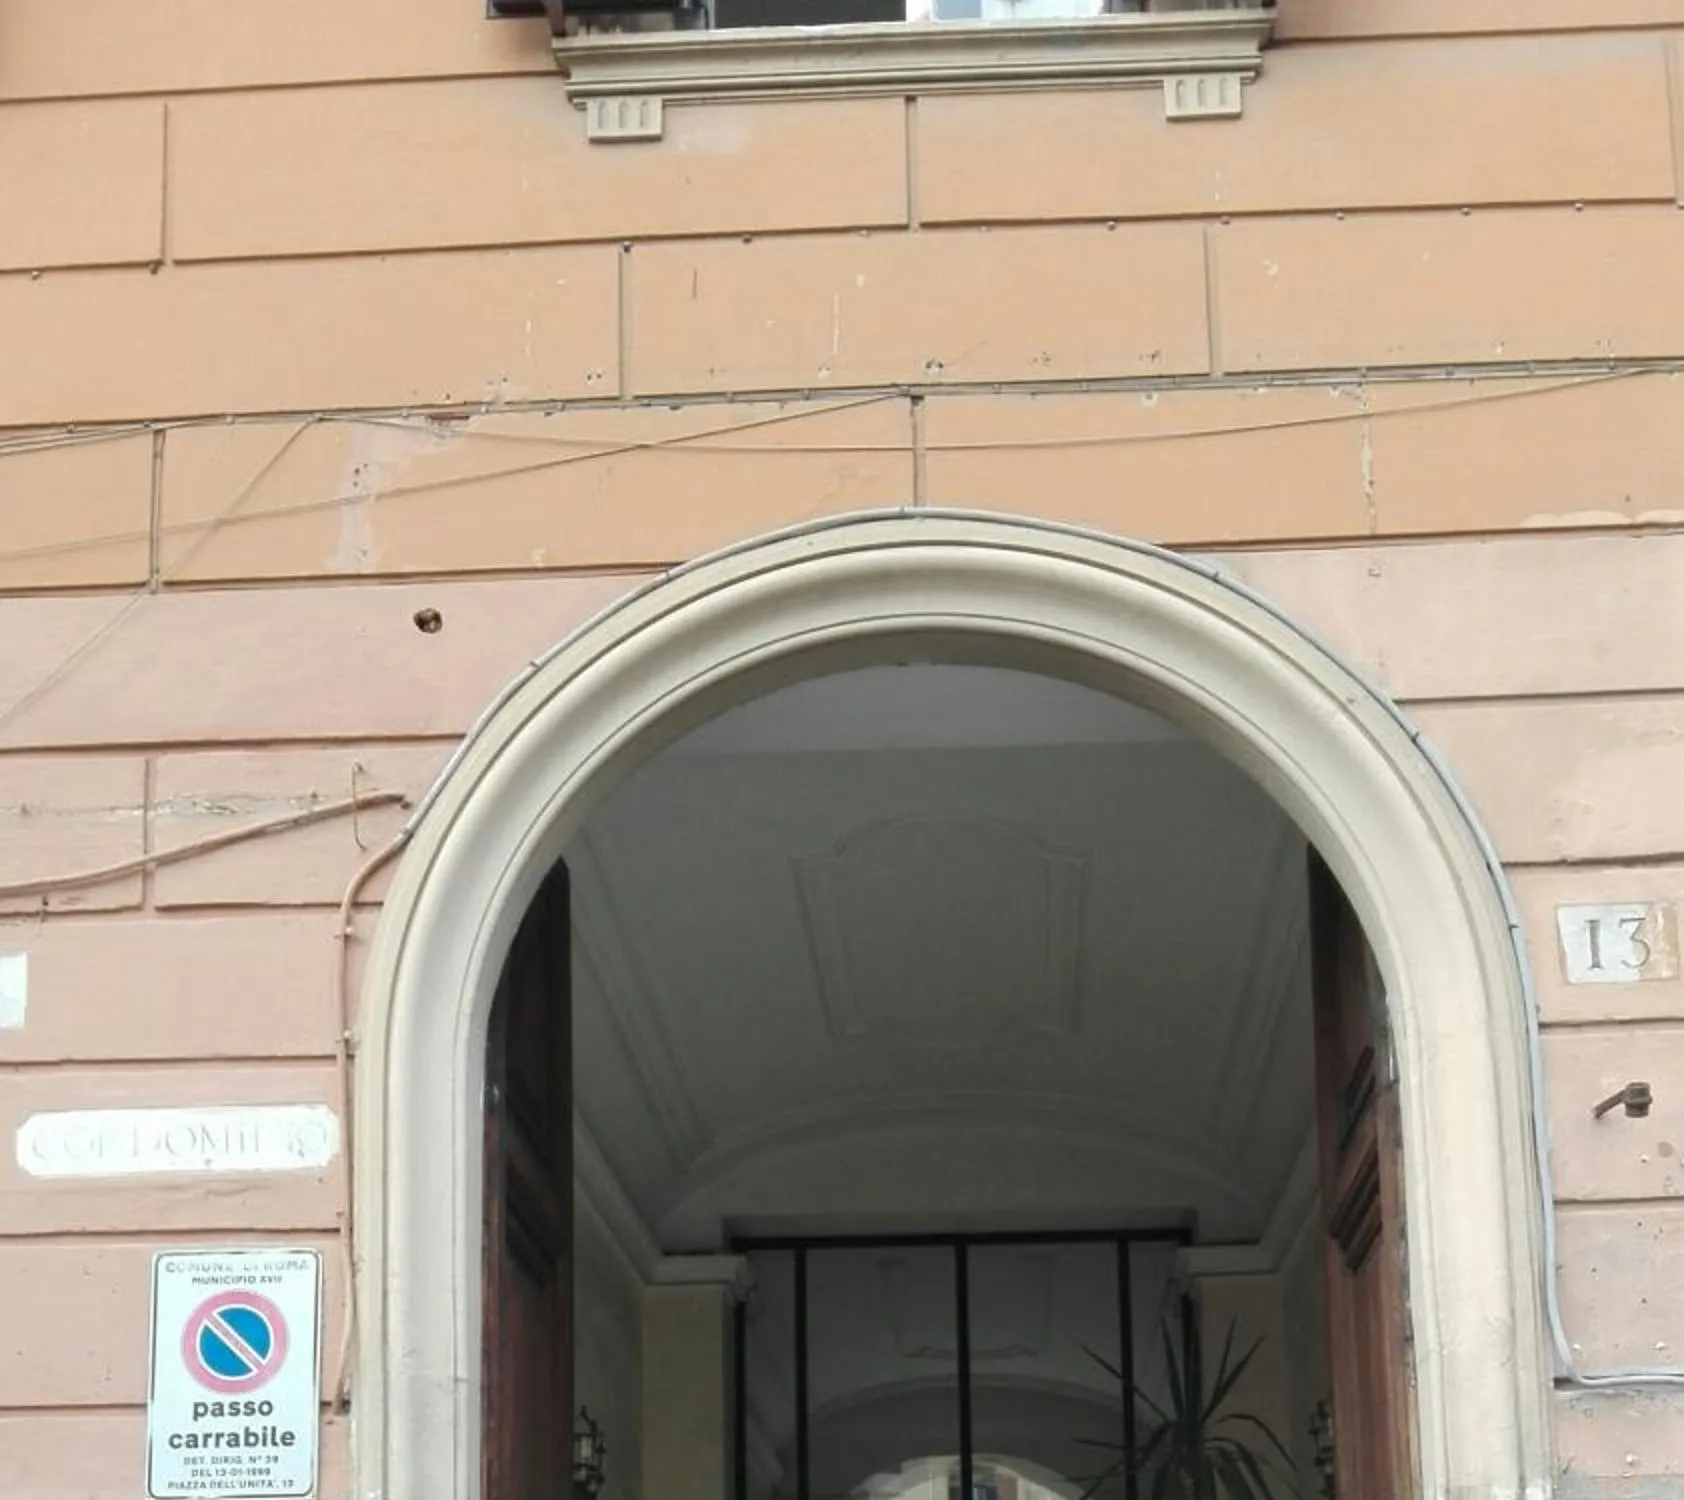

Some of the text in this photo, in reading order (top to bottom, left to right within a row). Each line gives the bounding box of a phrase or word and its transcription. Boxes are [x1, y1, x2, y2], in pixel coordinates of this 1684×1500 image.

[1583, 917, 1651, 970] 13
[191, 1275, 257, 1285] MUNICIPIO
[193, 1400, 273, 1422] passo
[168, 1426, 296, 1450] carrabile
[191, 1468, 212, 1477] DEL
[167, 1481, 207, 1489] PIAZZA
